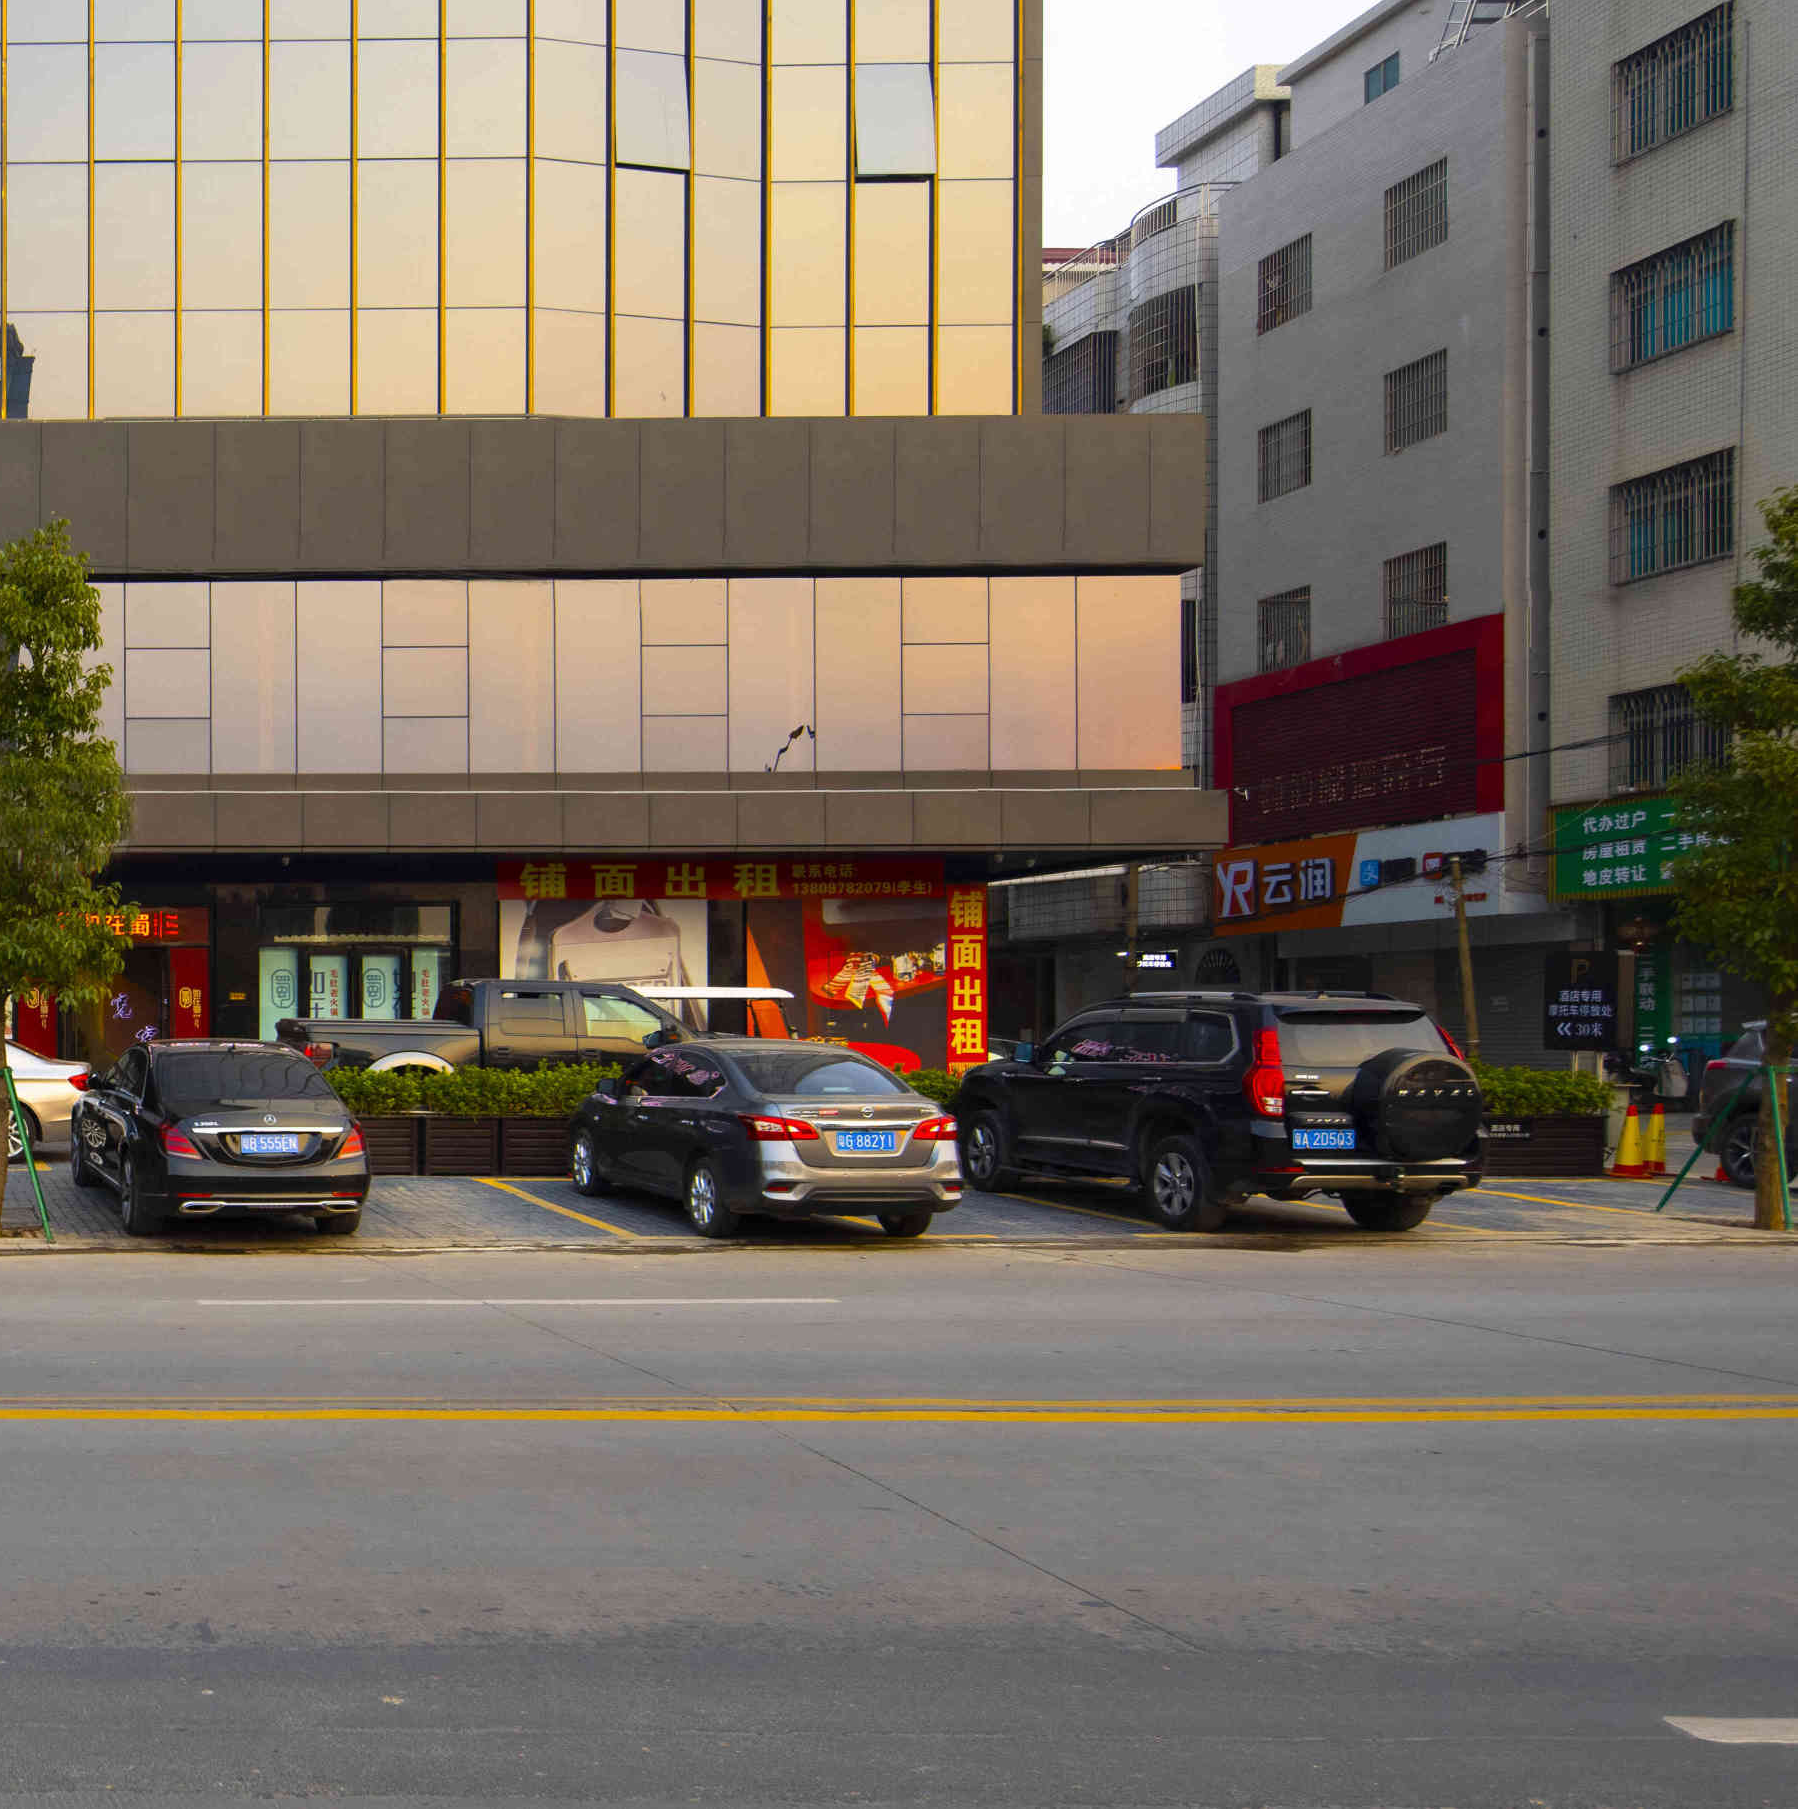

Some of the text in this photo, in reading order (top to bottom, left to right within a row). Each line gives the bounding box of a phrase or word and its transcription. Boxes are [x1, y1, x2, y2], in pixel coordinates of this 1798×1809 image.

[519, 862, 780, 898] 铺面出租
[1263, 858, 1332, 905] 云润
[950, 891, 985, 1055] 铺面出租
